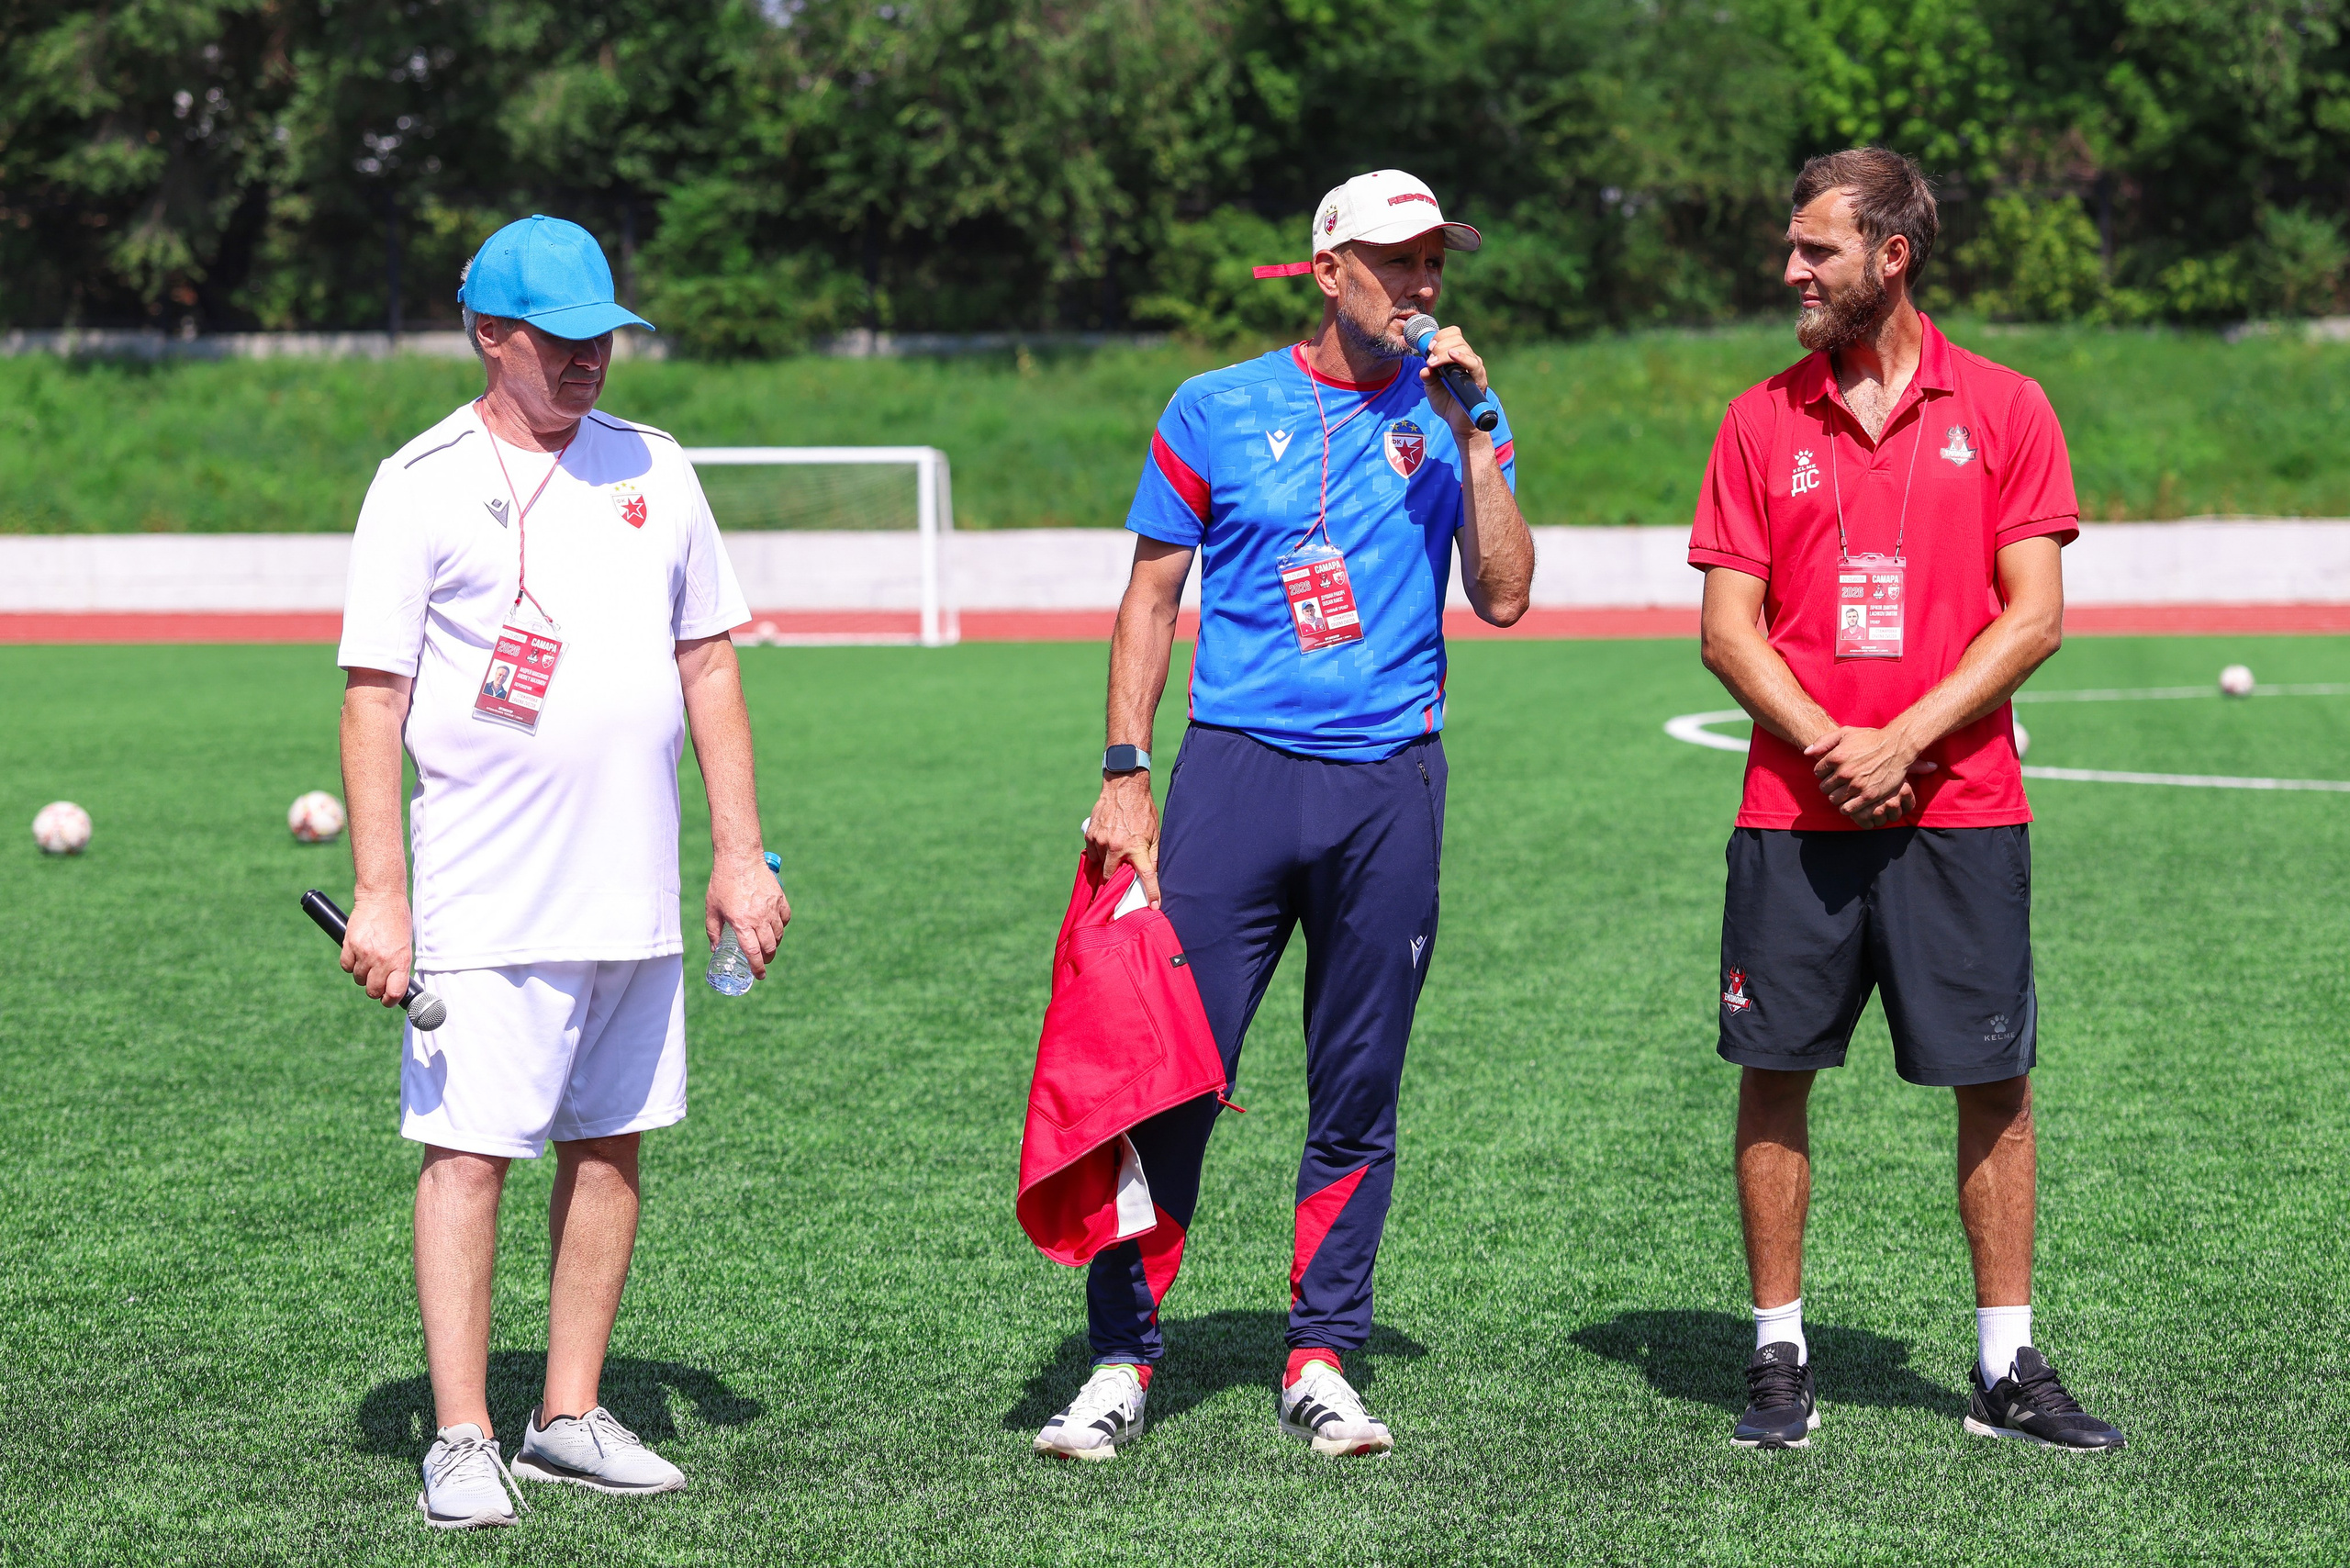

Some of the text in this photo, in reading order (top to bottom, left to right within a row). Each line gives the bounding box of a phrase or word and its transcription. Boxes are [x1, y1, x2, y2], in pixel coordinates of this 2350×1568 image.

[1793, 464, 1817, 474] KELME
[1791, 468, 1819, 497] ДС
[1315, 560, 1341, 574] САМАРА
[1873, 575, 1898, 583] САМАРА
[1289, 580, 1312, 596] 2026
[1841, 587, 1863, 598] 2026
[498, 640, 521, 657] 2026
[532, 638, 558, 653] САМАРА
[1984, 1032, 2016, 1041] KELME
